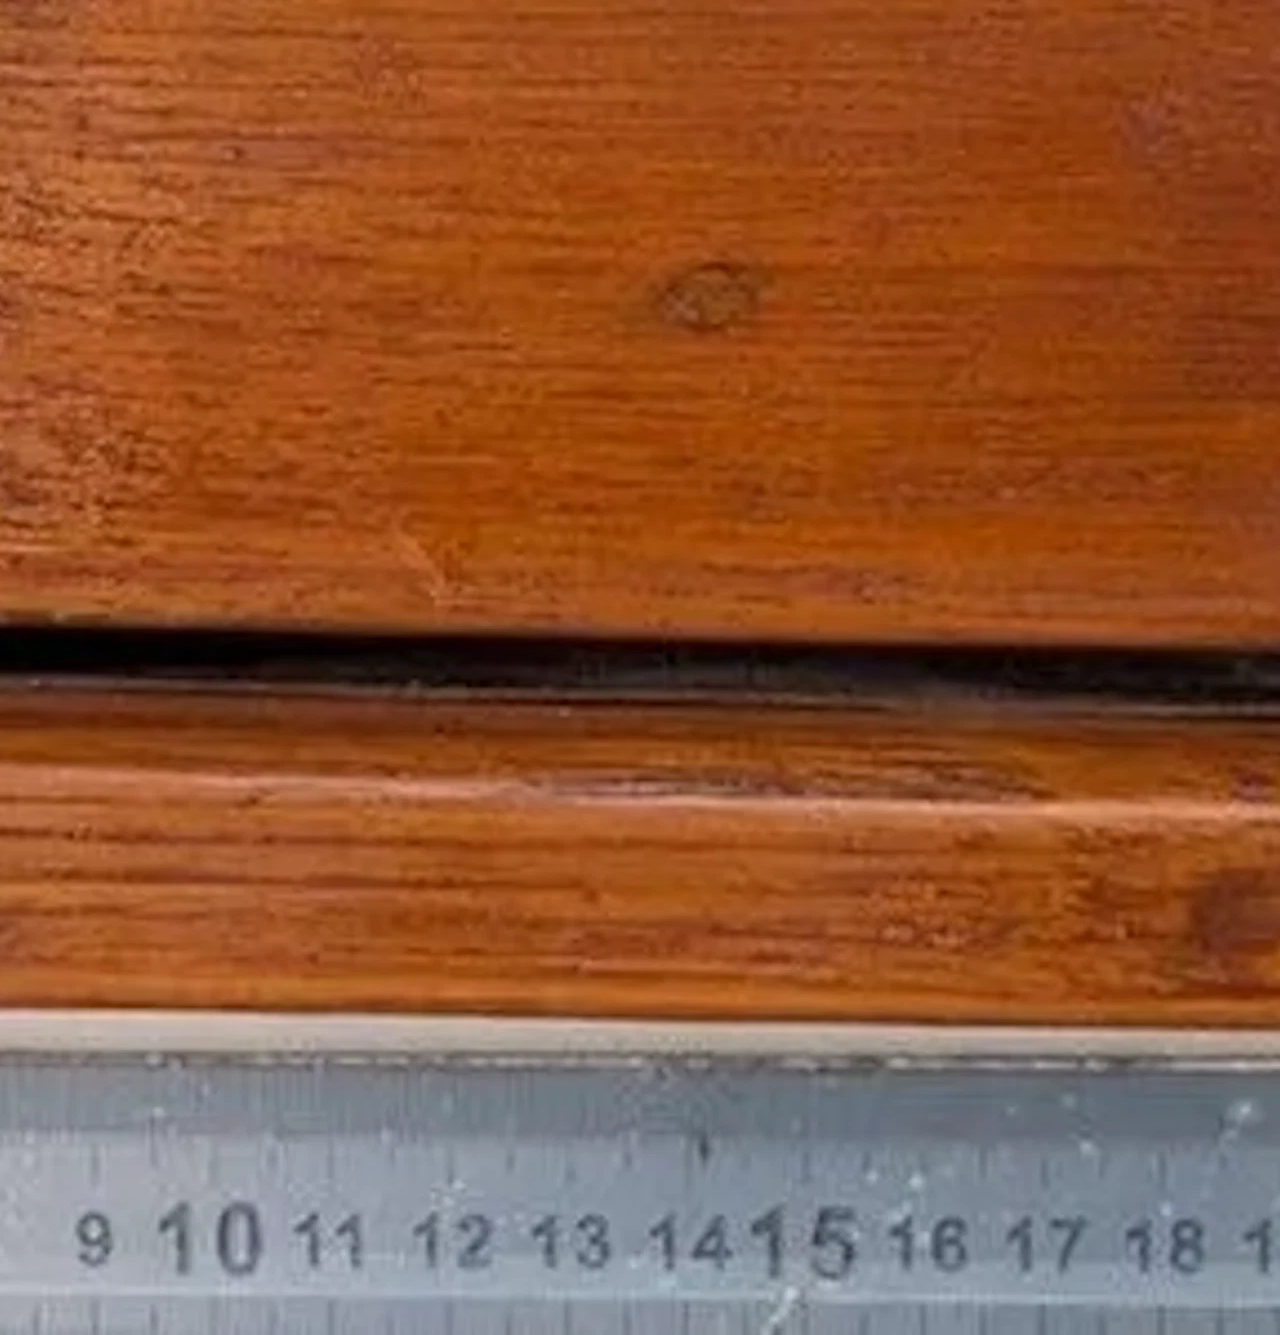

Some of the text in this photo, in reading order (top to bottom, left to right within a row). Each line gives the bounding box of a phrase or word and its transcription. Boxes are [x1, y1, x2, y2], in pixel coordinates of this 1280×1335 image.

[77, 1212, 113, 1267] 9
[158, 1202, 263, 1275] 10
[294, 1212, 363, 1269] 11
[412, 1212, 492, 1269] 12
[531, 1212, 612, 1270] 13
[649, 1214, 732, 1270] 14
[750, 1206, 860, 1280] 15
[890, 1218, 967, 1272] 16
[1006, 1218, 1089, 1272] 17
[1125, 1219, 1206, 1273] 18
